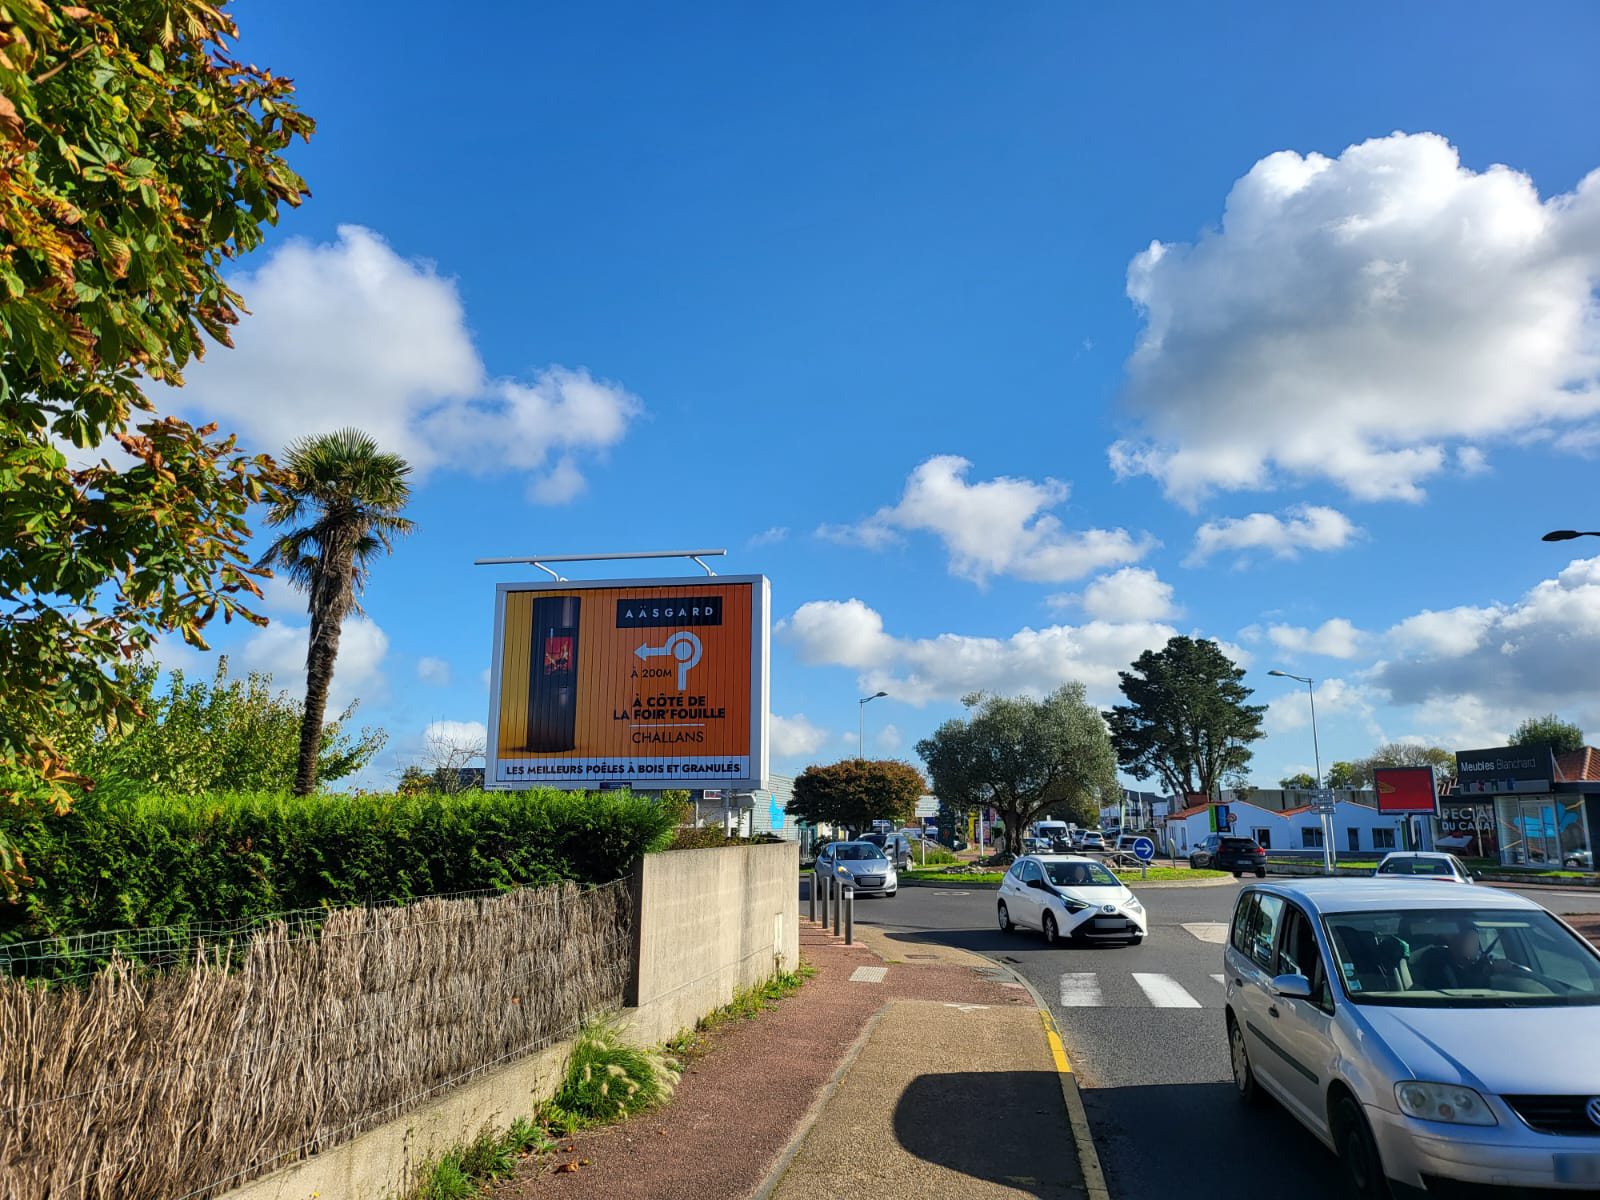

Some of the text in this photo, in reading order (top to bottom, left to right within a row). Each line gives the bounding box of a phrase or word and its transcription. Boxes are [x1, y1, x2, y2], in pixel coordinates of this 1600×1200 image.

[625, 605, 714, 619] AÄSGARD
[631, 666, 673, 679] À 200M
[633, 692, 705, 708] À CÔTÉ DE
[614, 708, 726, 720] LA FOIR'FOUILLE
[632, 731, 704, 744] CHALLANS
[506, 761, 741, 775] LES MEILLEURS POÊLES À BOIS ET GRANULÉS
[1461, 757, 1537, 772] Meubles Blanchard
[1441, 821, 1456, 832] DU
